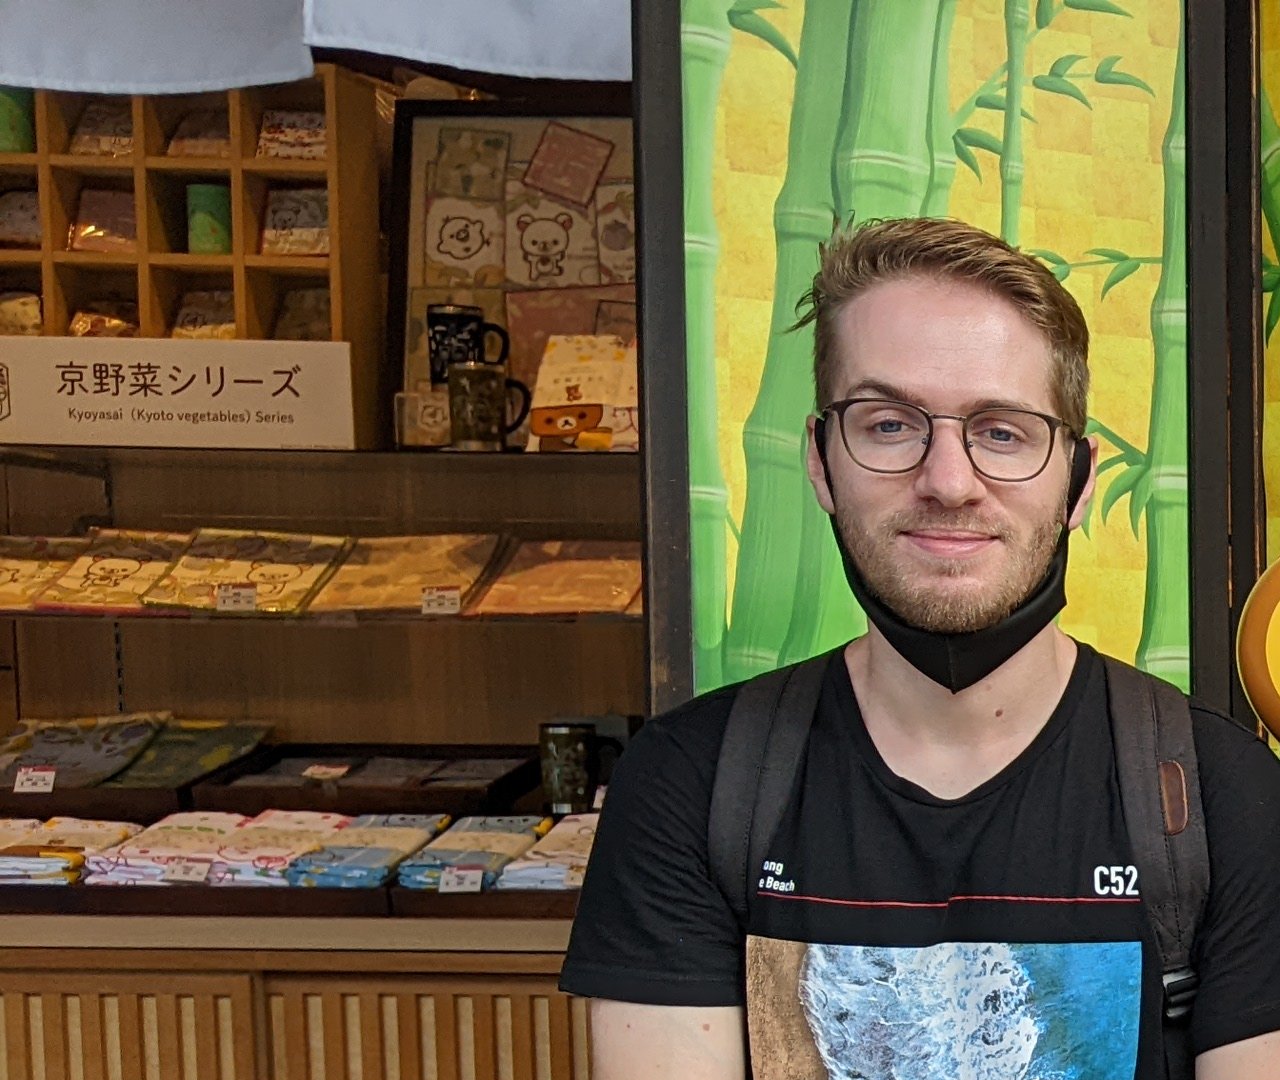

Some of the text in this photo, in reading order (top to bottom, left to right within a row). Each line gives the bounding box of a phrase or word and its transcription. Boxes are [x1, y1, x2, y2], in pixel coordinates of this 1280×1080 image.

[55, 360, 301, 398] 京野菜シリーズ
[68, 407, 123, 422] Kyoyasai
[177, 409, 251, 424] vegetables)
[255, 411, 294, 424] Series
[763, 860, 784, 875] ong
[765, 875, 795, 892] Beach
[1093, 865, 1140, 896] C52
